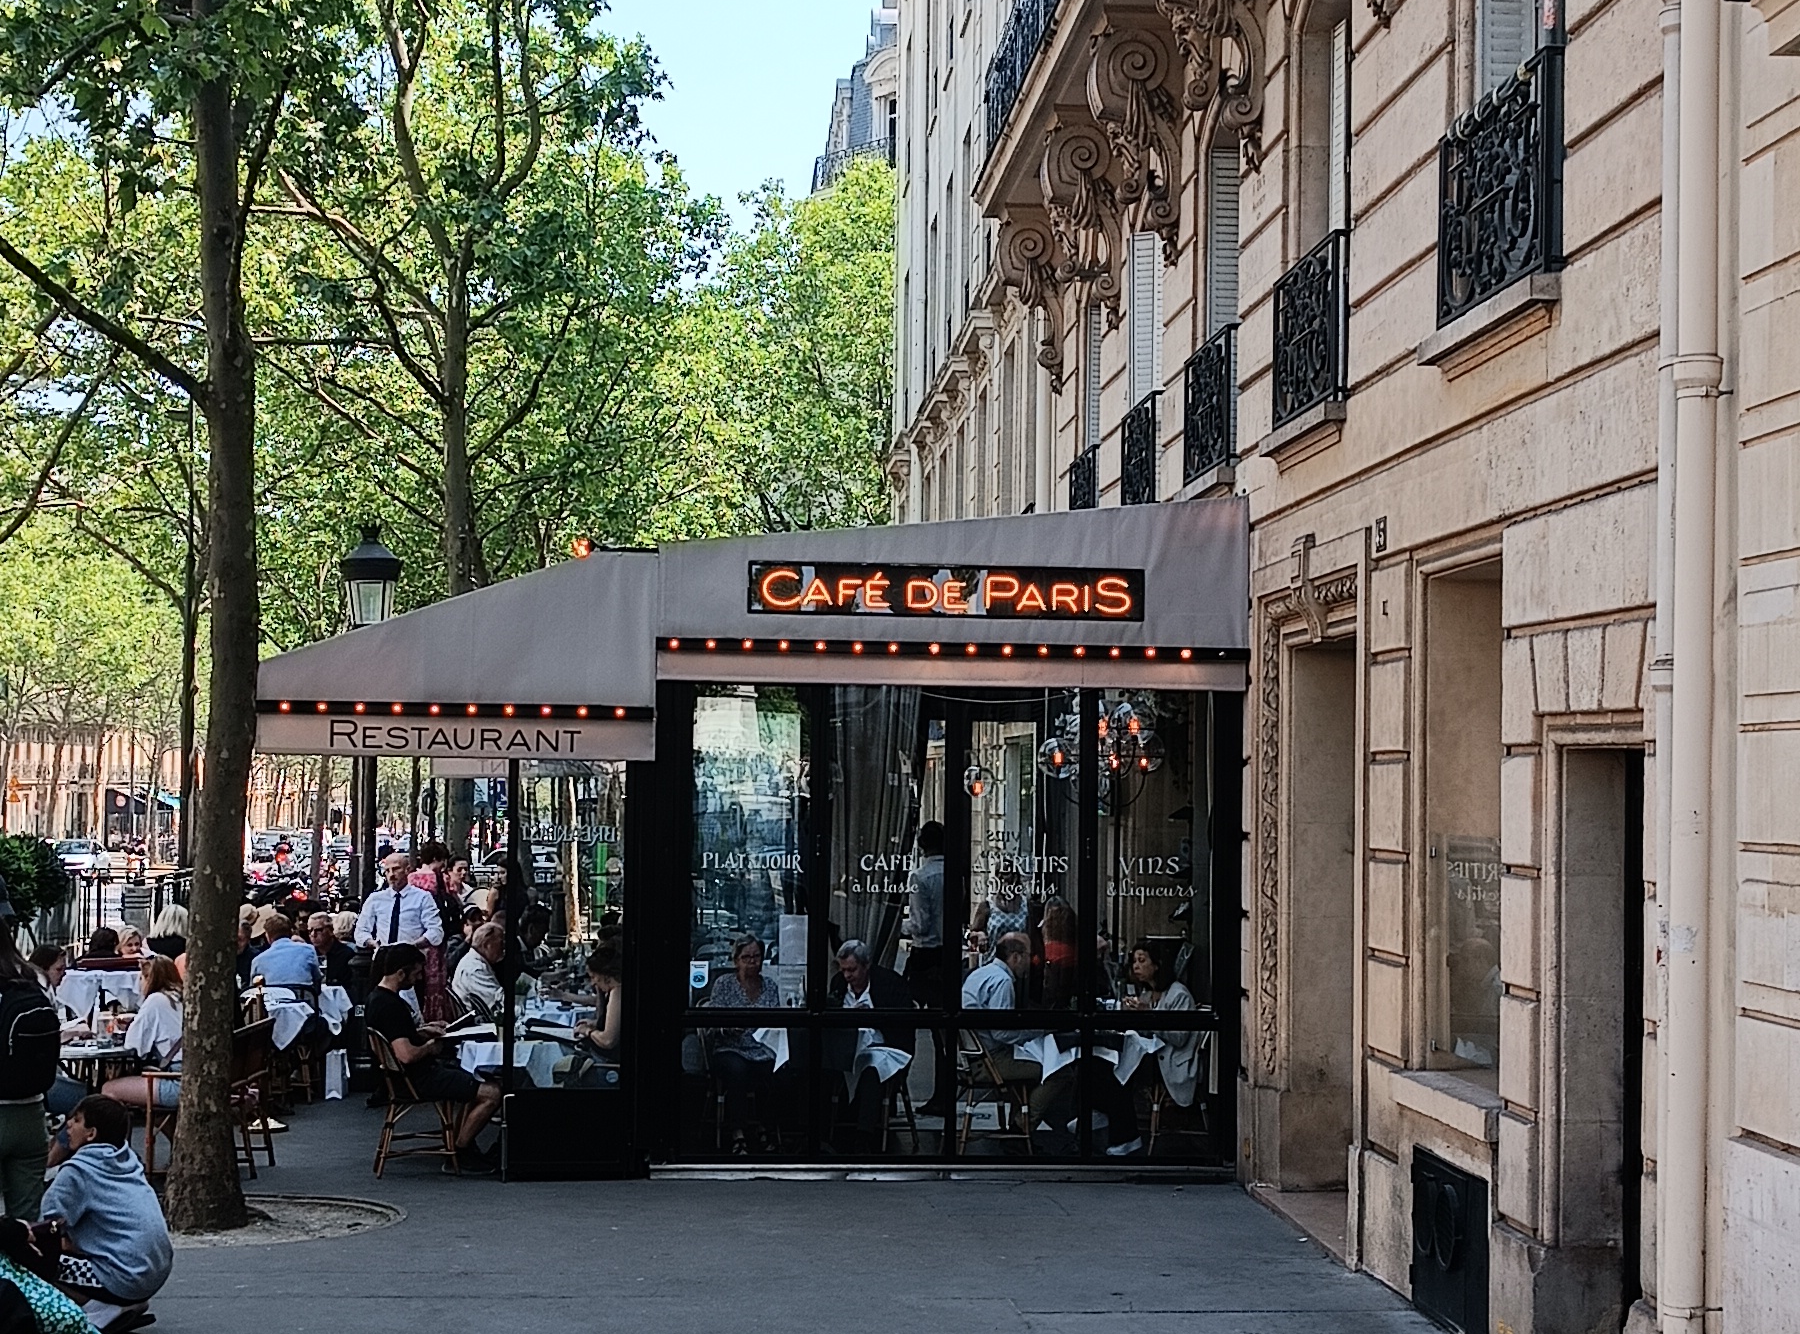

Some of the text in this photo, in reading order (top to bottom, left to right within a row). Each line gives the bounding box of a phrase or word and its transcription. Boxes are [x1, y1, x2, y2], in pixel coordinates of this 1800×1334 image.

[761, 570, 1131, 614] CAFÉ DE PARIS
[329, 719, 582, 753] RESTAURANT
[700, 851, 746, 869] PLAT
[762, 853, 804, 873] JOUR
[1119, 855, 1181, 875] VINS
[852, 878, 861, 893] à
[866, 874, 880, 893] la
[1106, 877, 1198, 906] & Liqueurs
